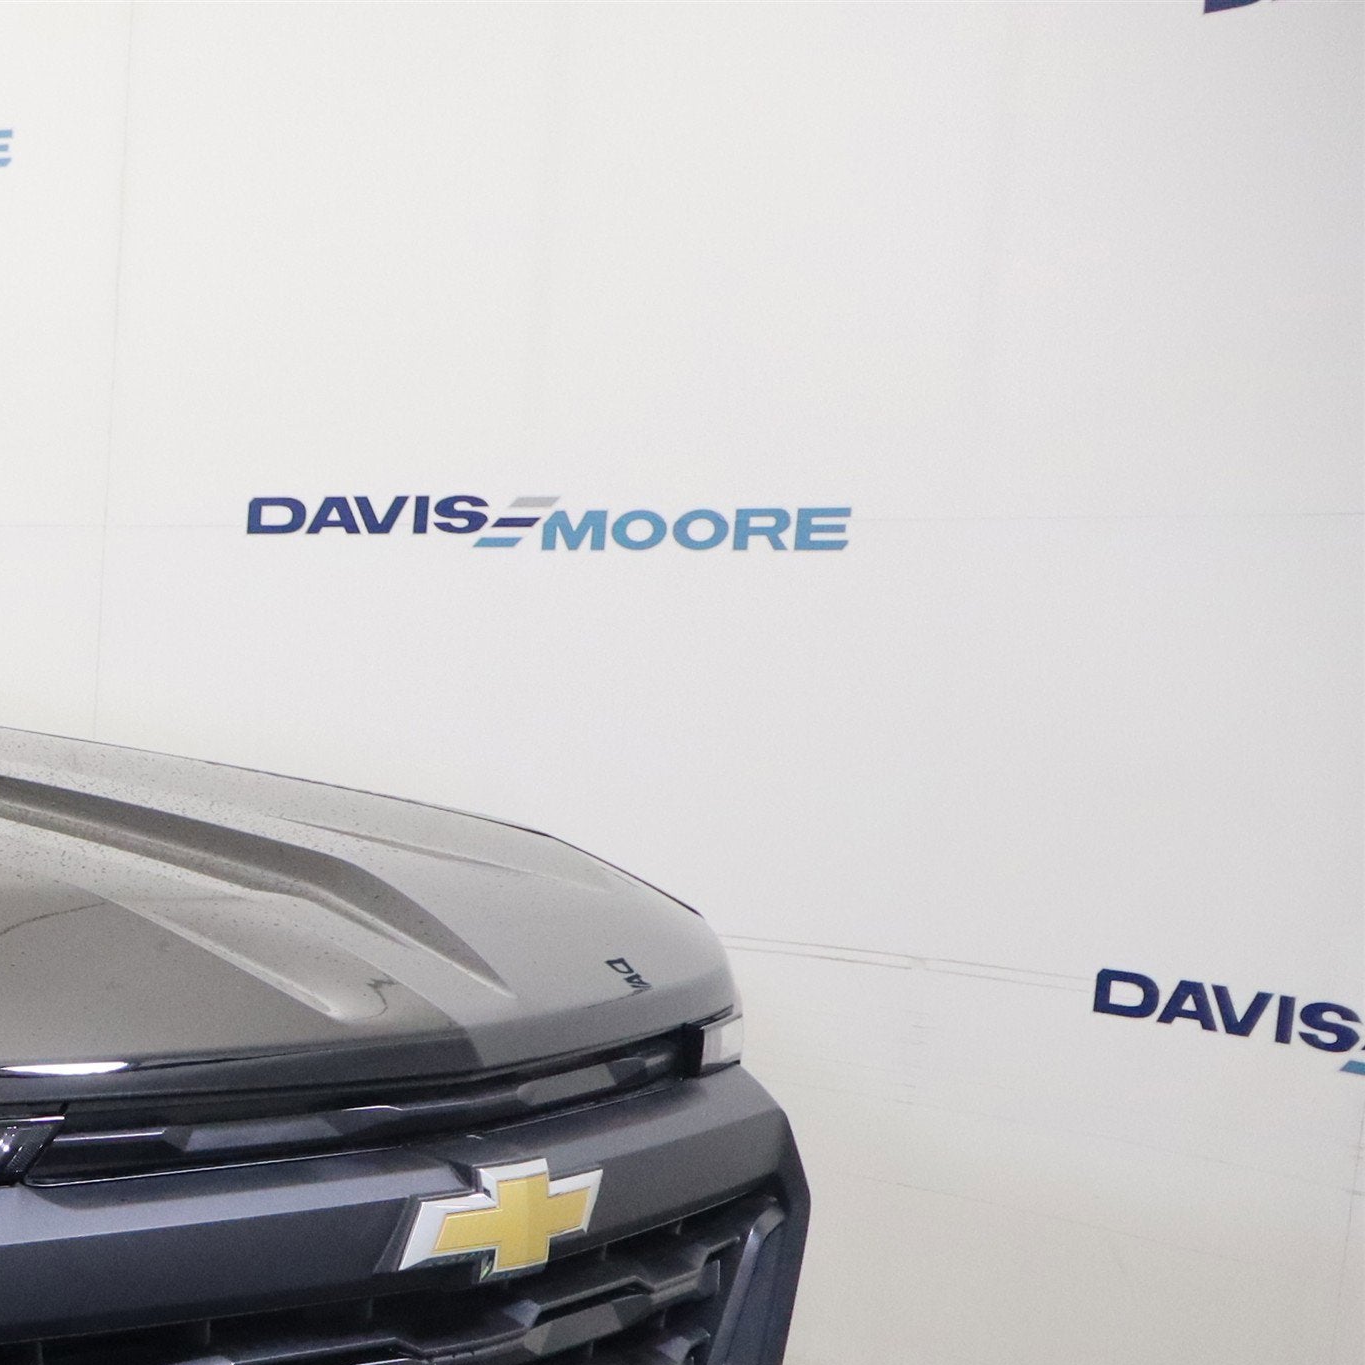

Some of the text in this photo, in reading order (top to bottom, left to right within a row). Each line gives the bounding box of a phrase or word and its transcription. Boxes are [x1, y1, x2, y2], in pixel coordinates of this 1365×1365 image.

[246, 494, 852, 552] DAVIS MOORE
[1092, 967, 1363, 1053] DAVIS
